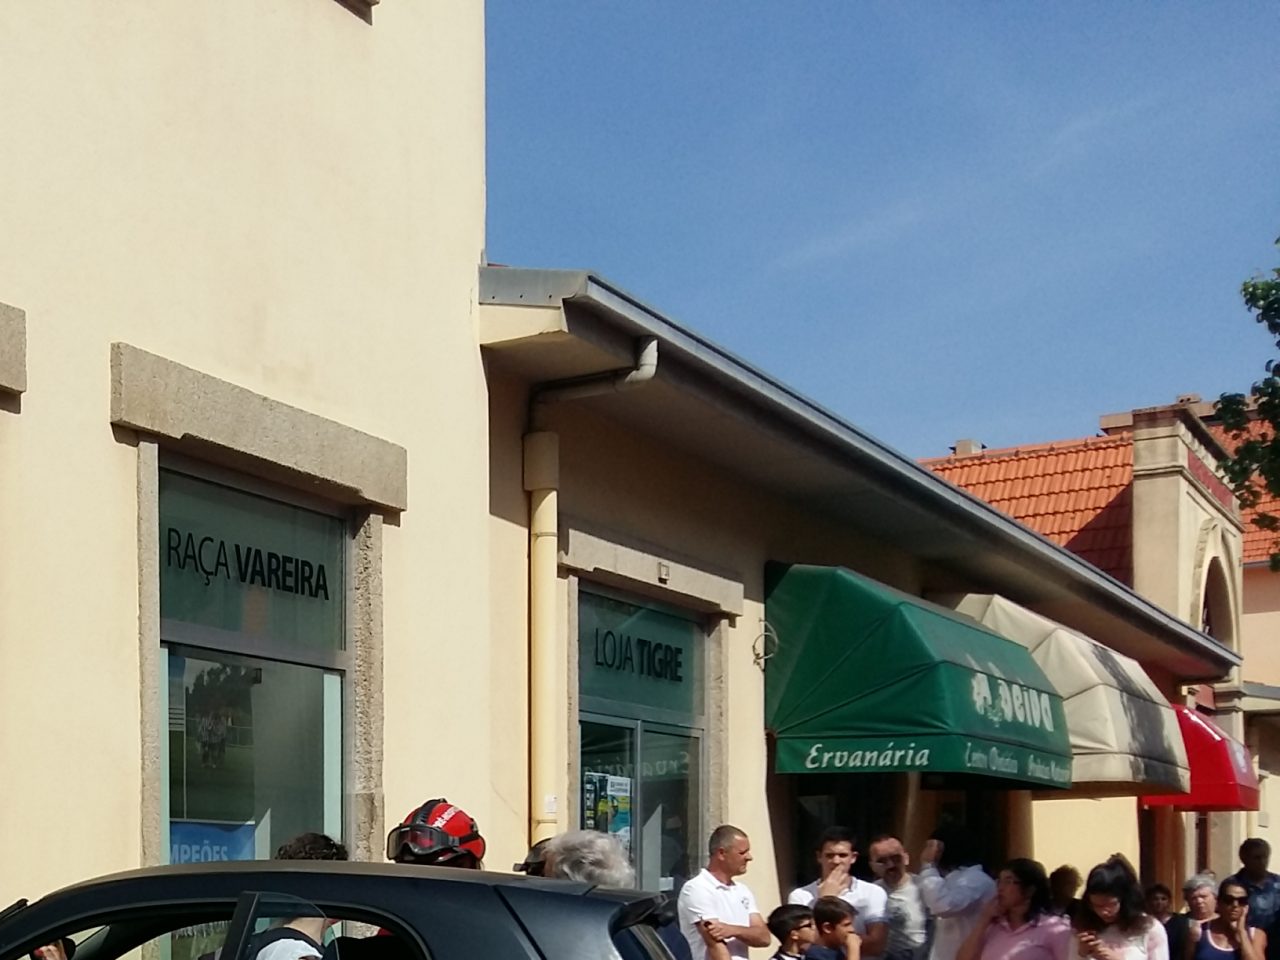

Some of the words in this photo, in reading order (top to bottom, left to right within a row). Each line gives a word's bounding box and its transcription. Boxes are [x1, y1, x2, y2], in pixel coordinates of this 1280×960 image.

[167, 527, 231, 587] RAÇA
[234, 543, 330, 601] VAREIRA
[595, 627, 635, 674] LOJA
[636, 637, 683, 683] TIGRE
[805, 741, 931, 769] Ervanária
